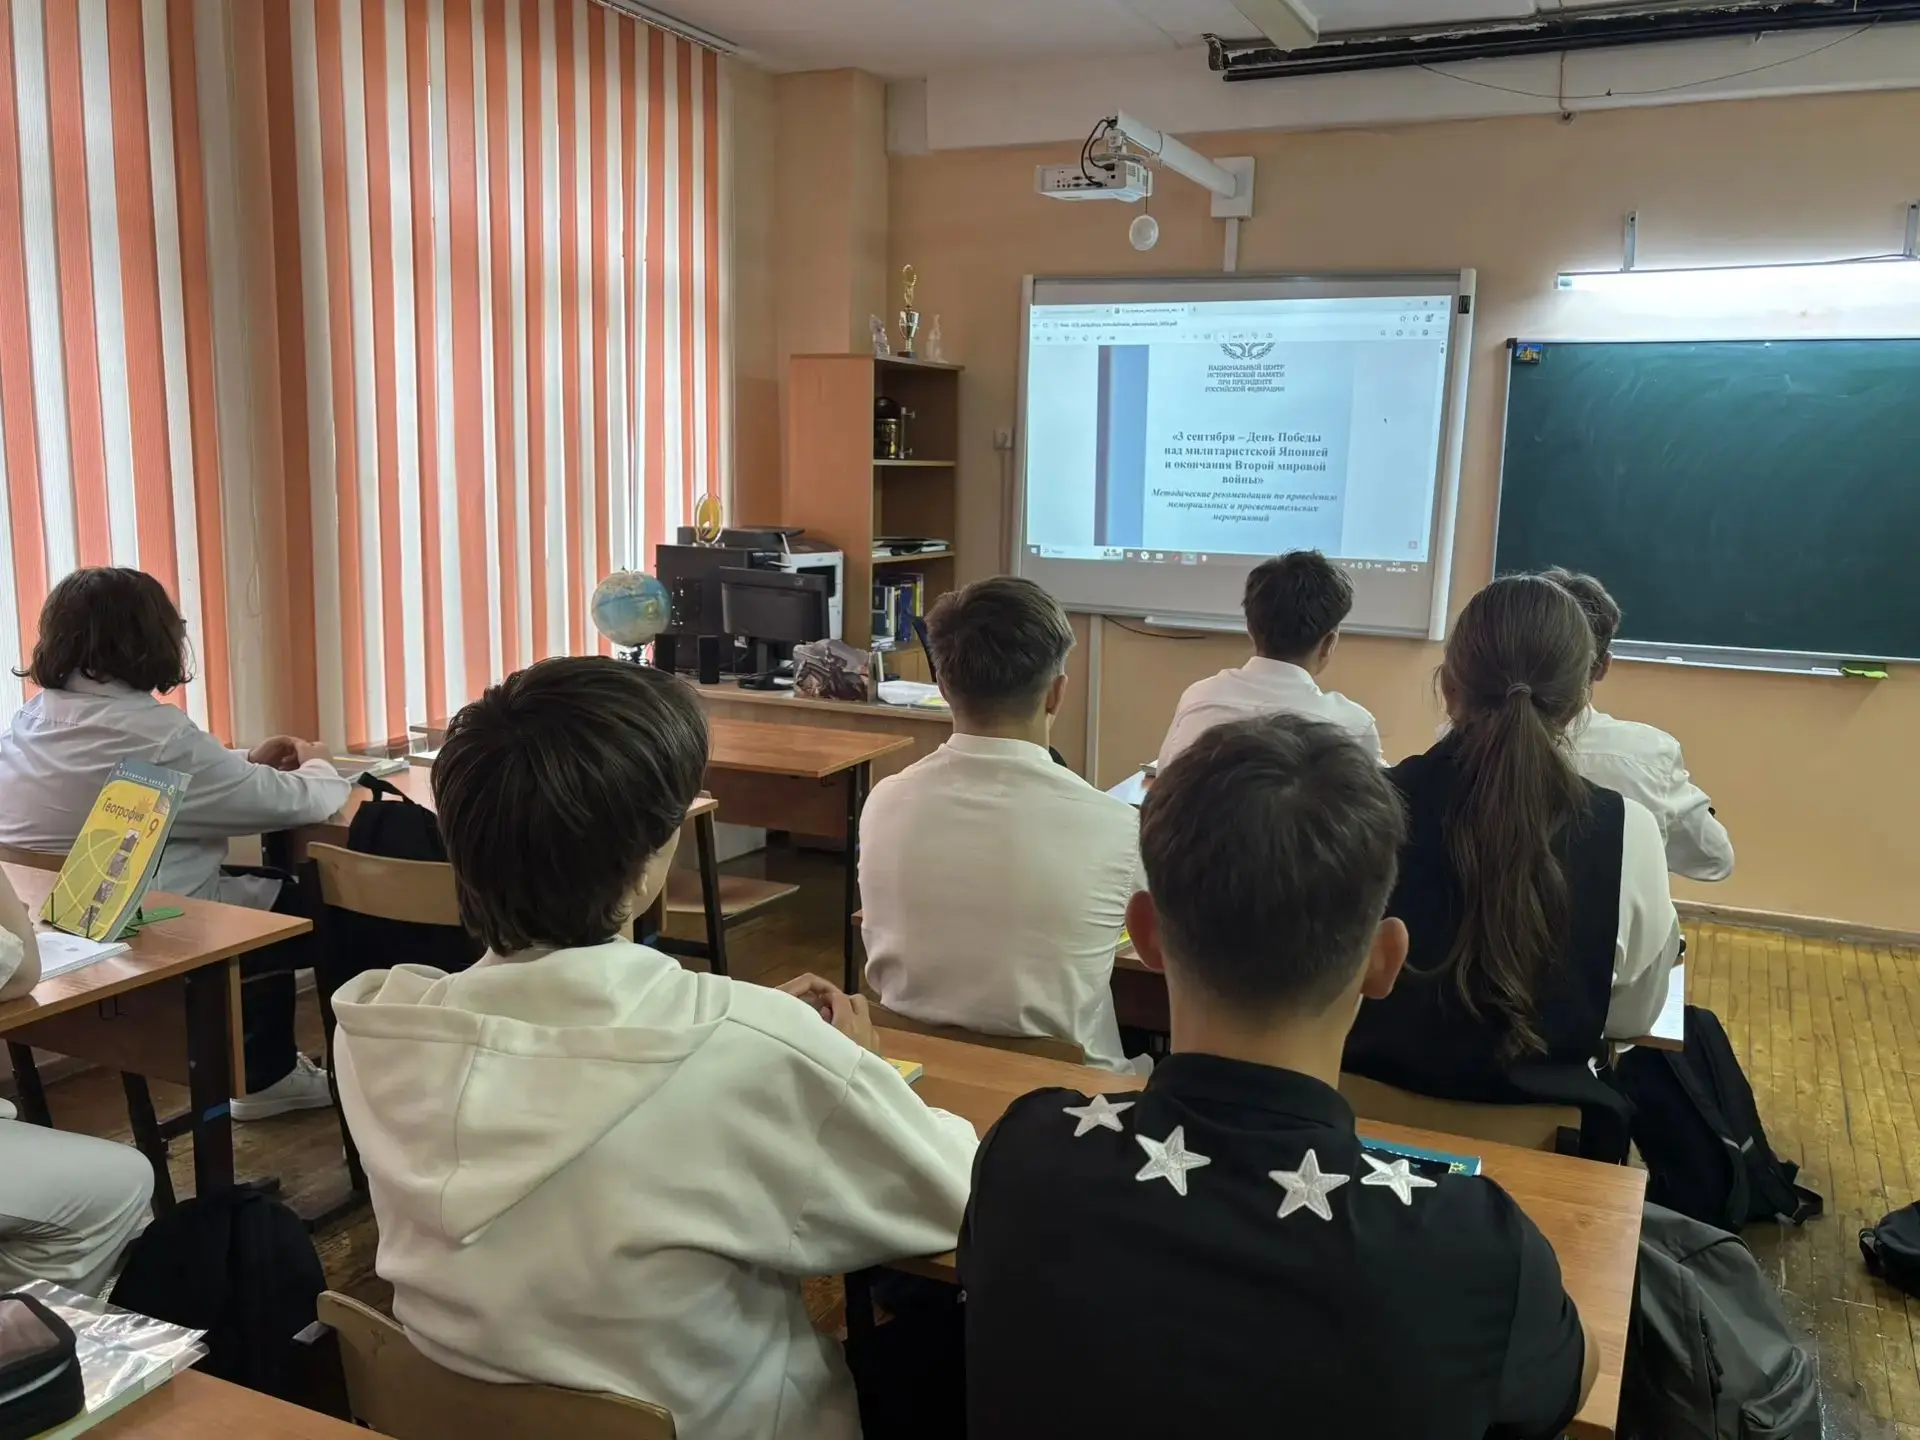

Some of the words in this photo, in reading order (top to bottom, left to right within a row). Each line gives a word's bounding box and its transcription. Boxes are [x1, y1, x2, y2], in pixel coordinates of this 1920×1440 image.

[1186, 432, 1235, 444] сентября
[1246, 431, 1275, 444] День
[1278, 432, 1322, 443] Победы
[1164, 447, 1183, 456] над
[1185, 446, 1276, 458] милитаристской
[1278, 446, 1328, 457] Японией
[1164, 461, 1171, 469] и
[1173, 461, 1232, 470] окончания
[1235, 460, 1274, 472] Второй
[1277, 461, 1326, 473] мировой
[1222, 474, 1264, 484] войны»
[1151, 489, 1211, 498] Методические
[1212, 490, 1271, 501] рекомендации
[1166, 501, 1229, 511] мемориальных
[1237, 503, 1319, 513] просветительских
[1211, 513, 1270, 523] мероприятий
[102, 797, 145, 824] География
[146, 818, 160, 839] 9
